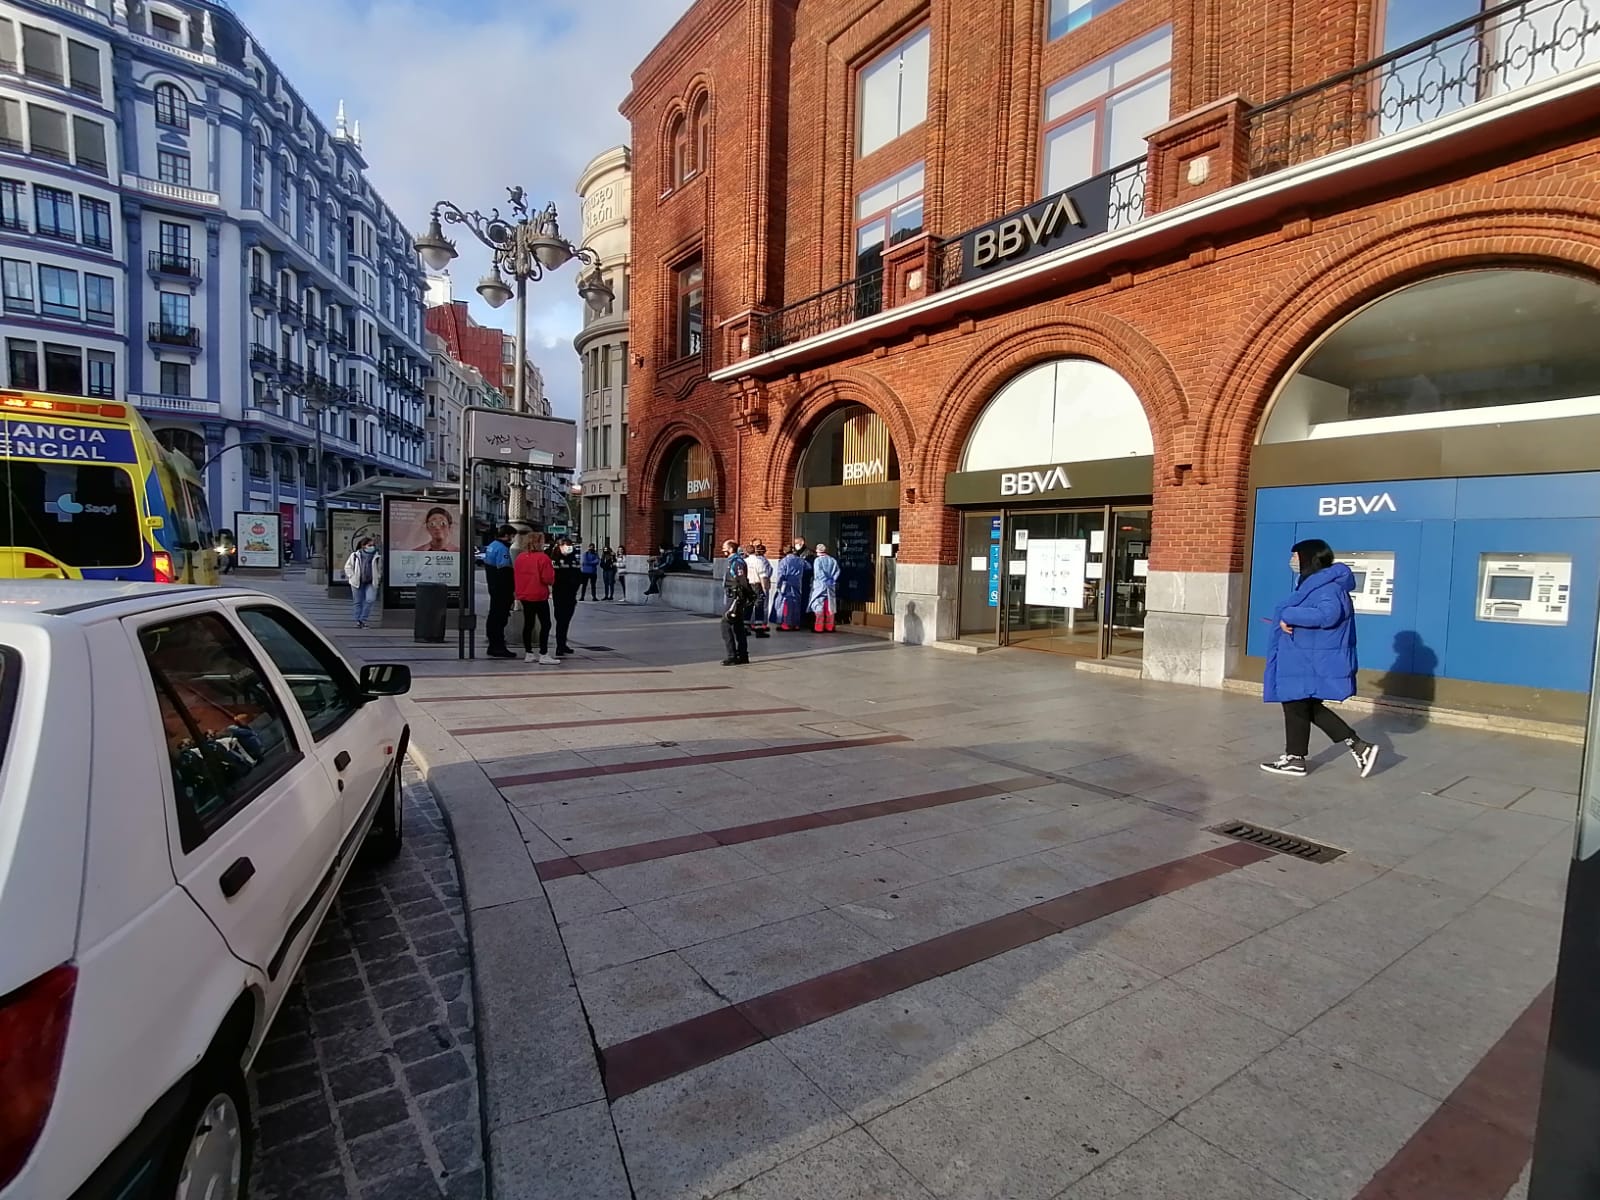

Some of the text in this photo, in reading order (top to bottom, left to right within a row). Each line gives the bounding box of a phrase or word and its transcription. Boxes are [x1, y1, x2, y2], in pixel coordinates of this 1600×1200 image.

[973, 192, 1081, 268] BBVA
[842, 458, 884, 480] BBVA
[1000, 466, 1072, 496] BBVA
[687, 477, 711, 493] BBVA
[1318, 492, 1397, 516] BBVA
